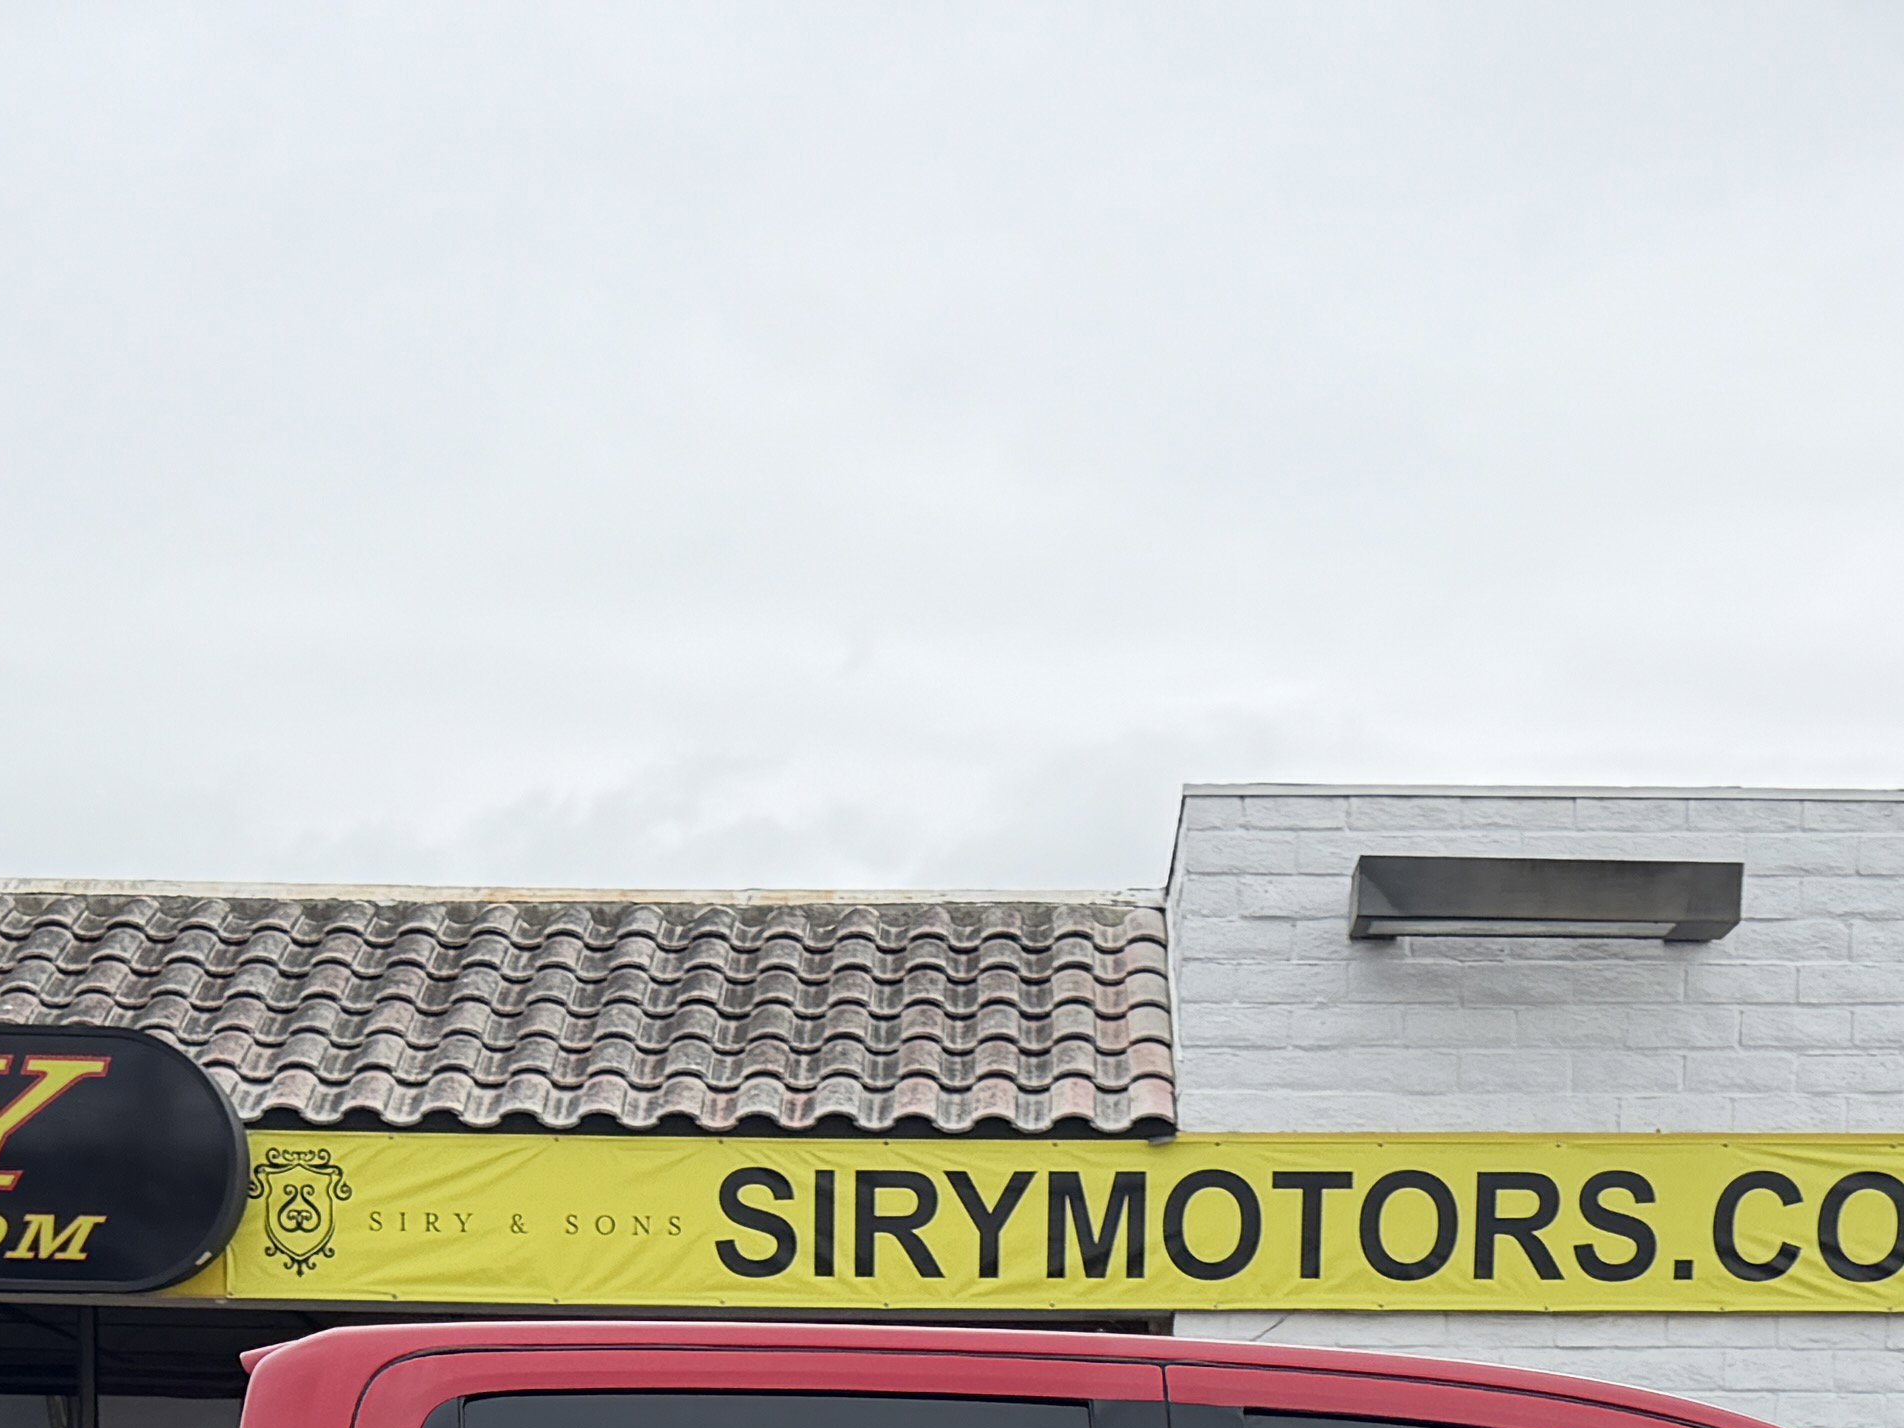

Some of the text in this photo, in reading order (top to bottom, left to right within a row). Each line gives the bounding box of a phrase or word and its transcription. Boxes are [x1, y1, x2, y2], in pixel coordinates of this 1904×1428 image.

[369, 1211, 682, 1237] SIRY & SONS
